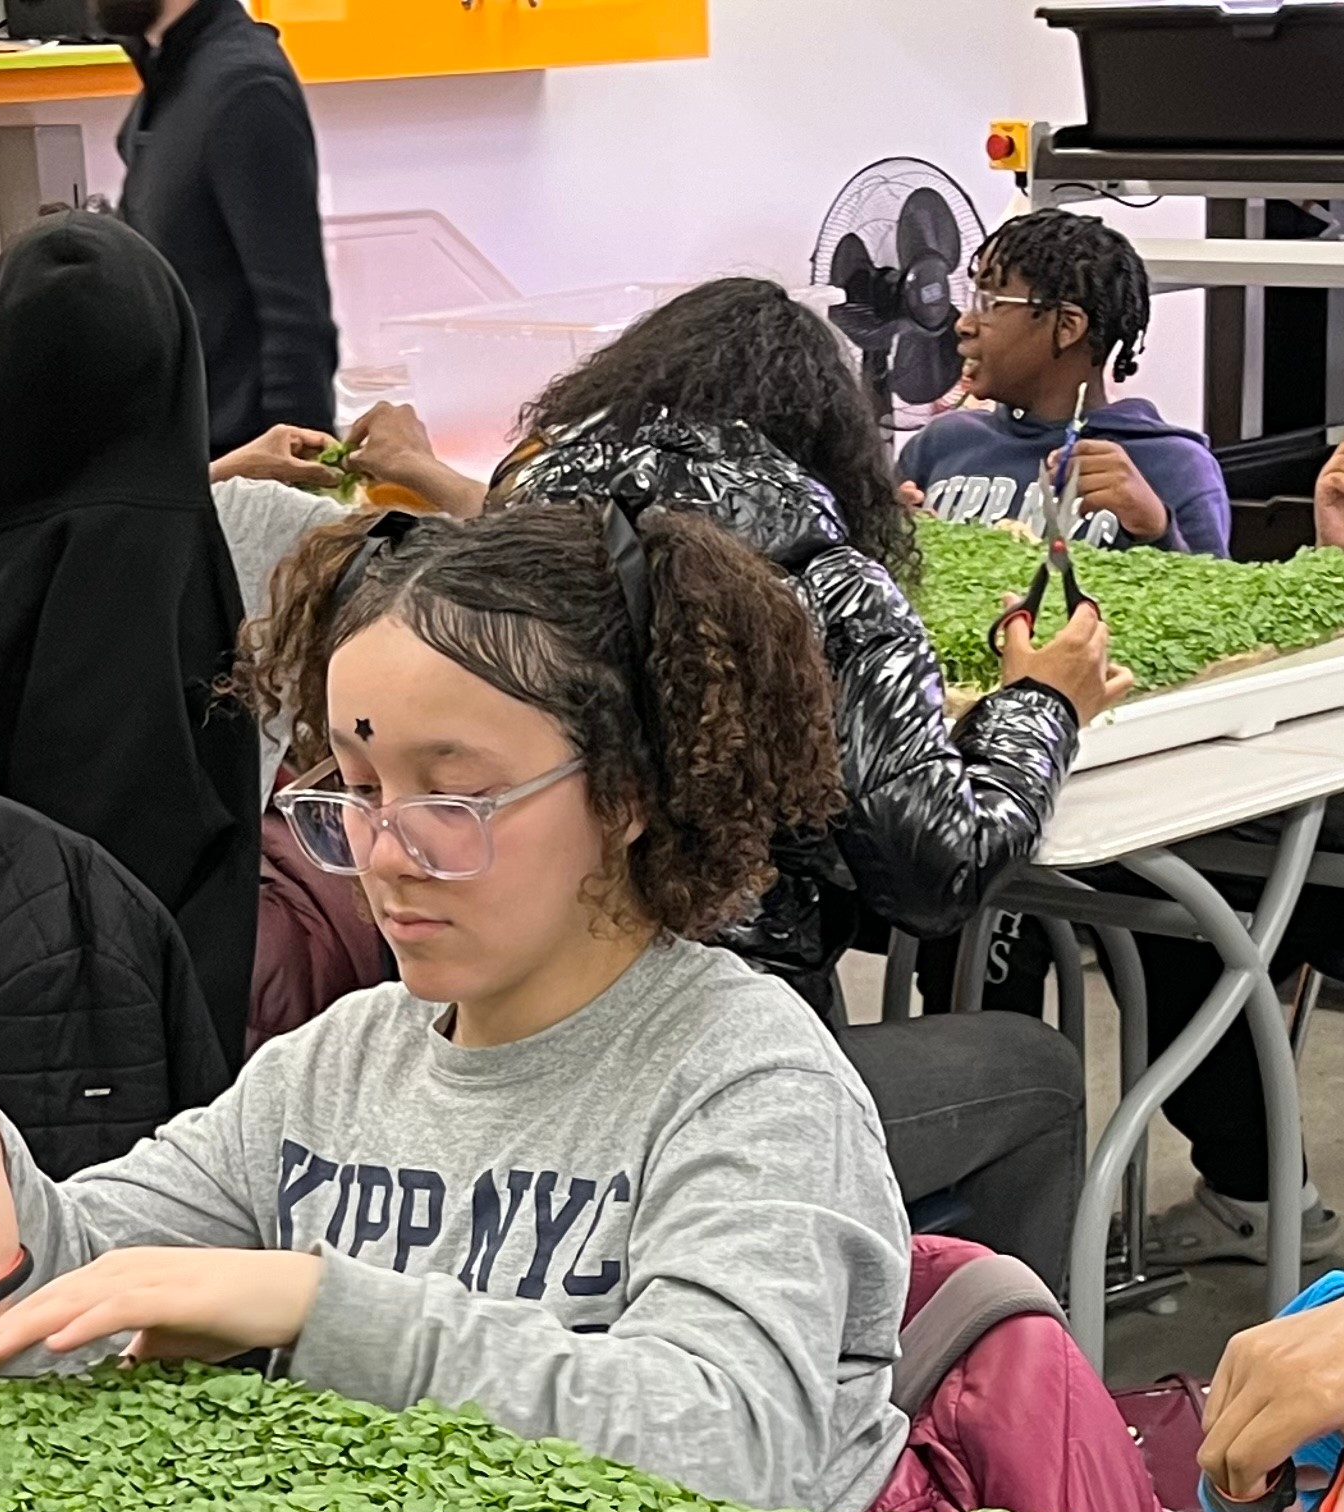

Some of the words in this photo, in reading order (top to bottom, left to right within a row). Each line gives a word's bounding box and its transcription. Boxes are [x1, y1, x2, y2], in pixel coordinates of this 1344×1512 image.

[922, 475, 1018, 527] IPP
[278, 1138, 446, 1273] KIPP
[457, 1168, 631, 1301] NYC
